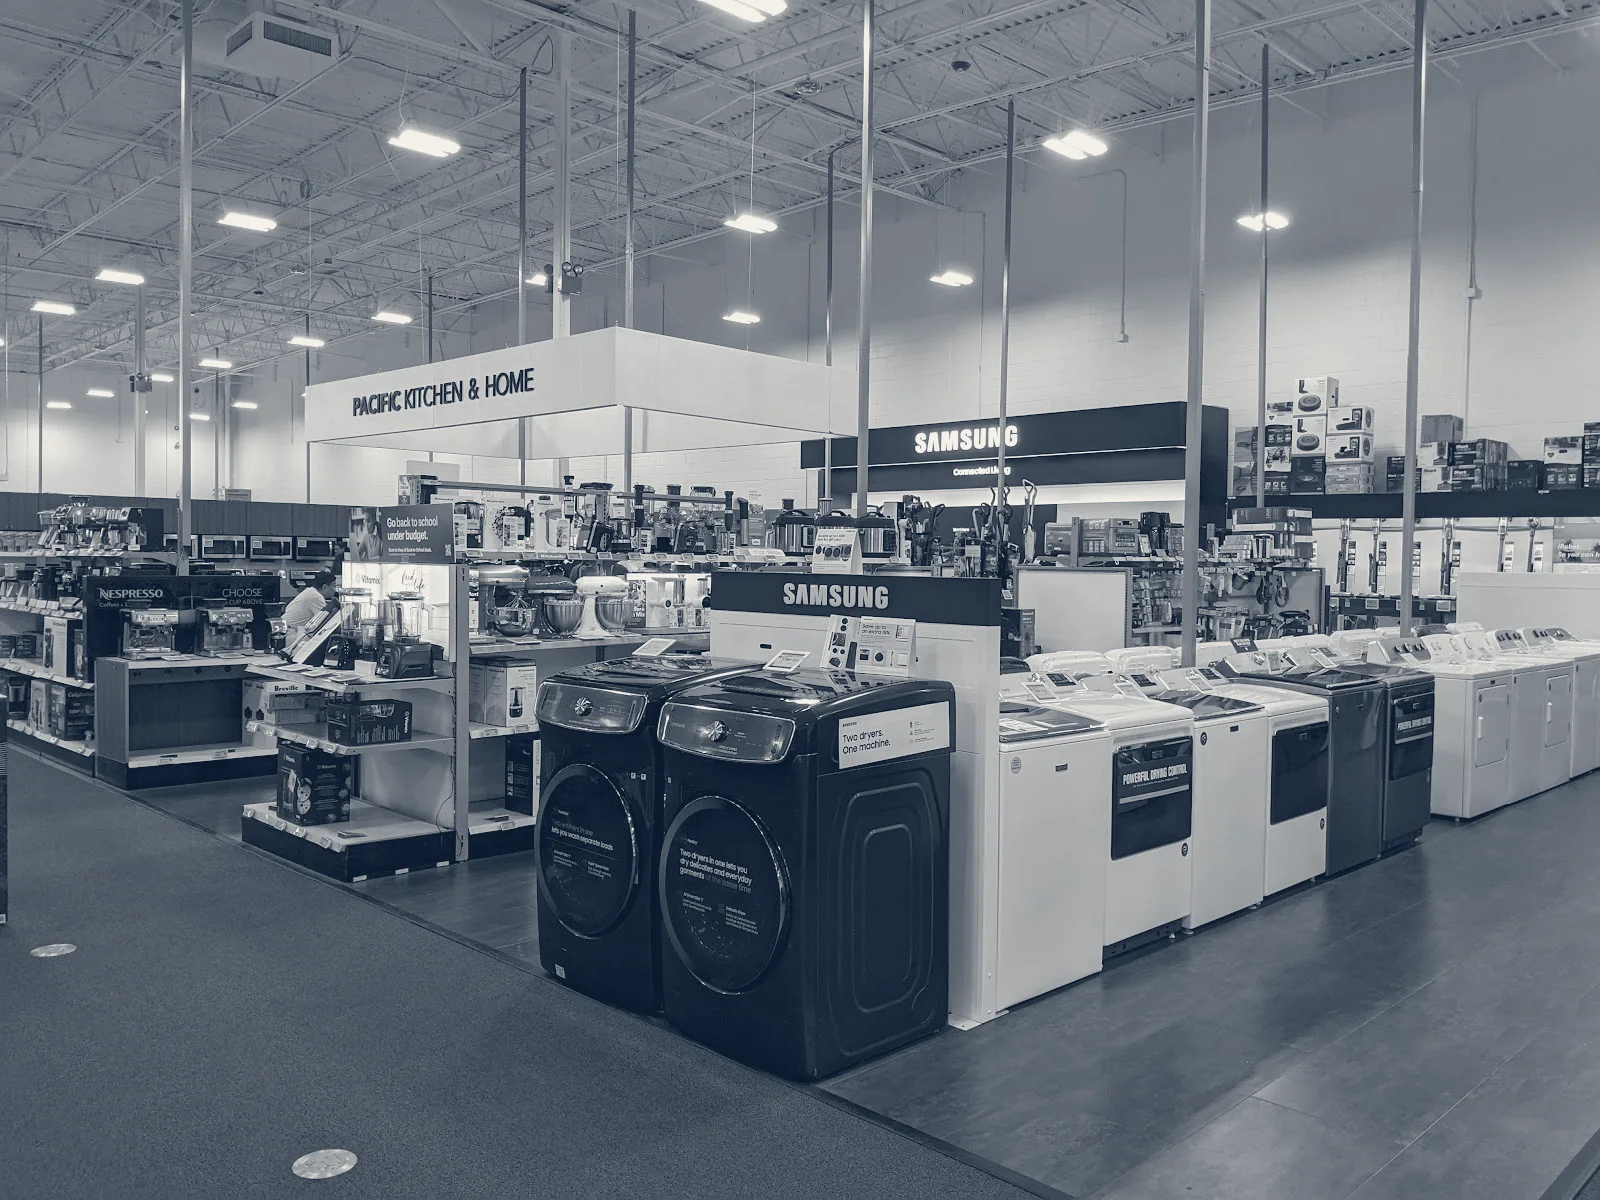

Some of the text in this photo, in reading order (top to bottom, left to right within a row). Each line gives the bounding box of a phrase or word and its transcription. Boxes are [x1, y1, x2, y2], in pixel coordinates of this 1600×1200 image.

[353, 367, 534, 416] PACIFIC KITCHEN & HOME
[915, 425, 1018, 454] SAMSUNG
[952, 465, 1011, 476] Connected Livg
[386, 516, 438, 528] Go back to school
[387, 530, 428, 542] under budget.
[361, 575, 381, 585] Vitamix
[97, 587, 263, 600] NESPRESSO CHOOSE
[783, 582, 889, 609] SAMSUNG
[842, 730, 884, 743] Two dryers.
[842, 739, 891, 755] One machine.
[1123, 770, 1150, 785] POWERFUL
[1150, 767, 1167, 780] DRYING
[1167, 763, 1188, 777] CONTROL
[551, 826, 559, 834] lets
[559, 829, 568, 837] you
[568, 831, 580, 840] wash
[600, 841, 614, 851] loads
[680, 848, 748, 874] Two dryers in one lets you
[679, 858, 753, 887] dry delicates and everyday
[679, 867, 705, 880] garments
[711, 874, 721, 884] the
[721, 879, 738, 890] same
[738, 883, 752, 893] time
